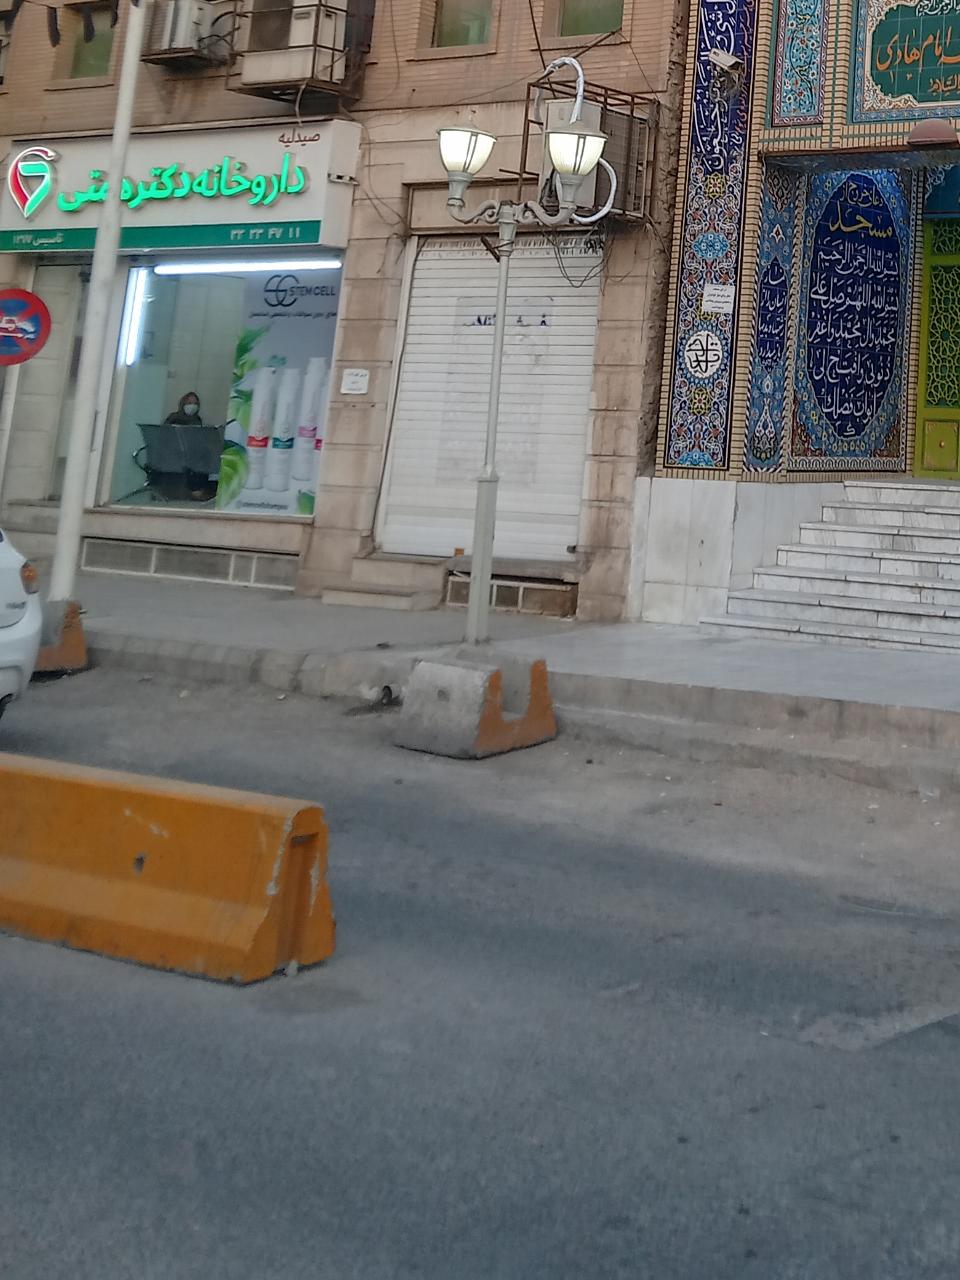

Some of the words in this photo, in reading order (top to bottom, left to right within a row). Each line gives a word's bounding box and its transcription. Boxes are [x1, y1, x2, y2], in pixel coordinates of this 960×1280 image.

[57, 169, 134, 213] هتی
[128, 162, 193, 209] دکتر
[192, 152, 306, 206] داروخانه
